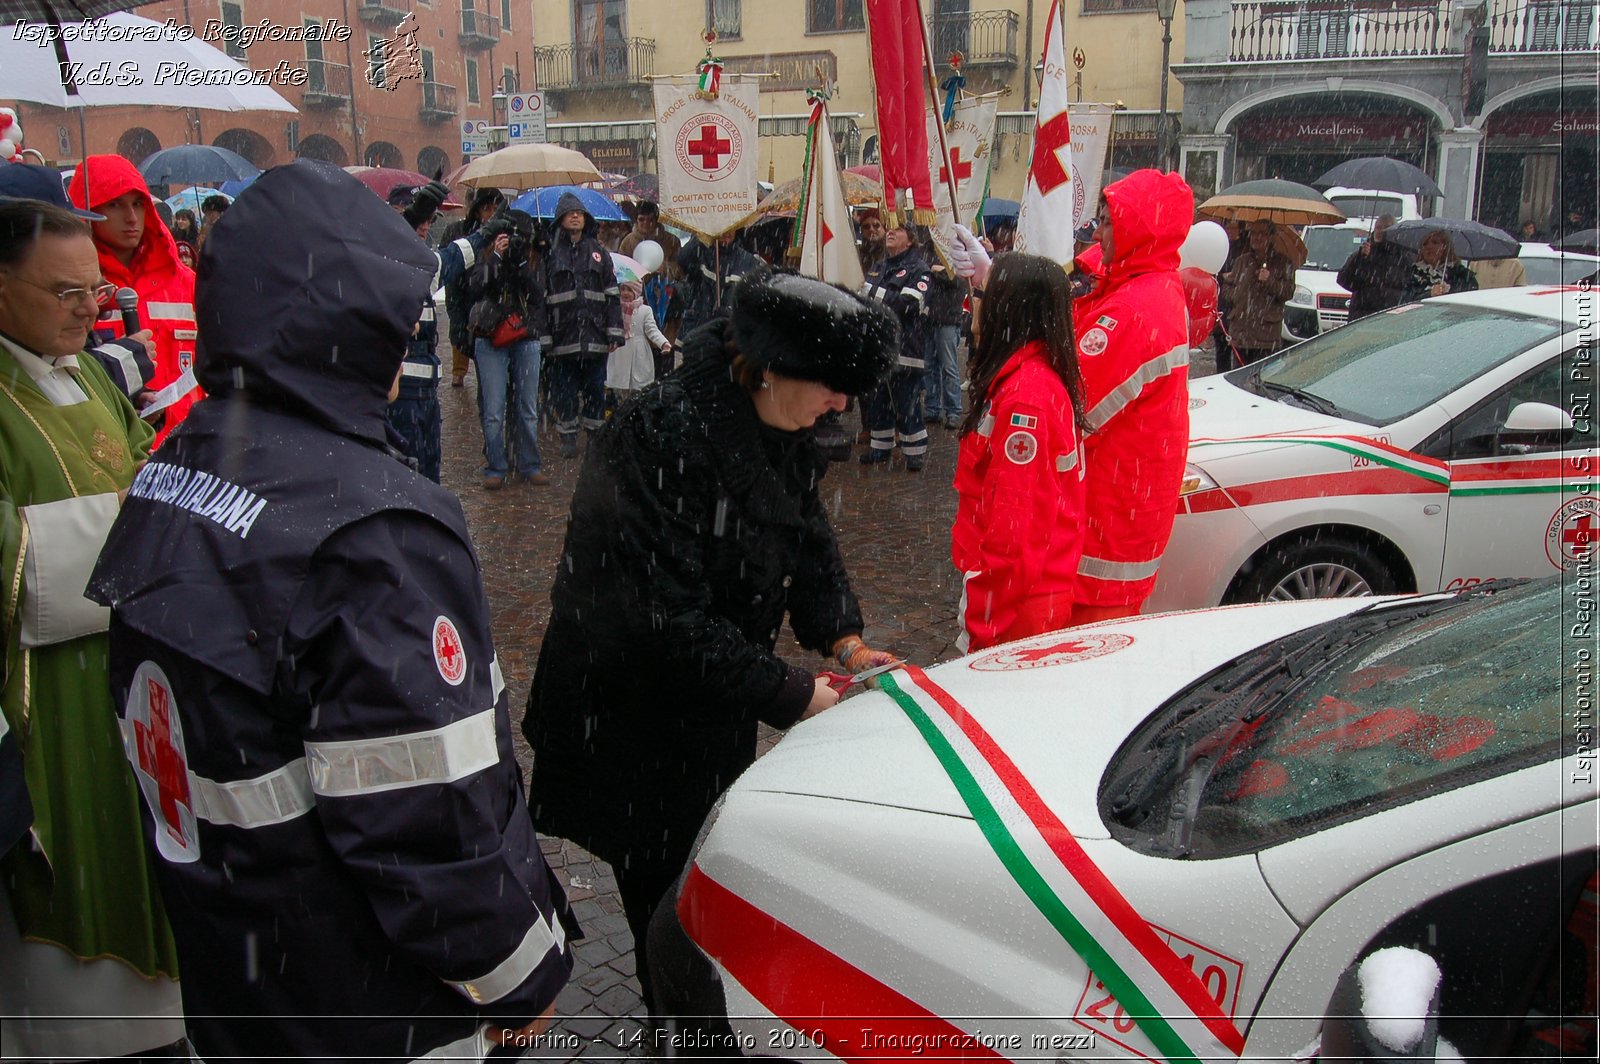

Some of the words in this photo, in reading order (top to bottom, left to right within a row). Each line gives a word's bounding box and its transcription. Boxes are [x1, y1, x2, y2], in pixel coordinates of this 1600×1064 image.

[660, 99, 686, 124] CROCE
[723, 93, 758, 122] ITALIANA
[689, 120, 697, 128] DI
[696, 115, 724, 125] GINEVRA
[724, 122, 733, 130] 22
[731, 129, 741, 158] AGOSTO
[1297, 121, 1364, 137] Macelleria
[667, 205, 707, 217] SETTIMO
[711, 203, 753, 213] TORINESE
[672, 193, 714, 203] COMITATO
[717, 192, 748, 200] LOCALE
[1076, 183, 1085, 218] AGOSTO
[176, 470, 267, 539] ITALIANA
[1549, 511, 1568, 538] CROCE
[1568, 500, 1594, 513] ROSSA
